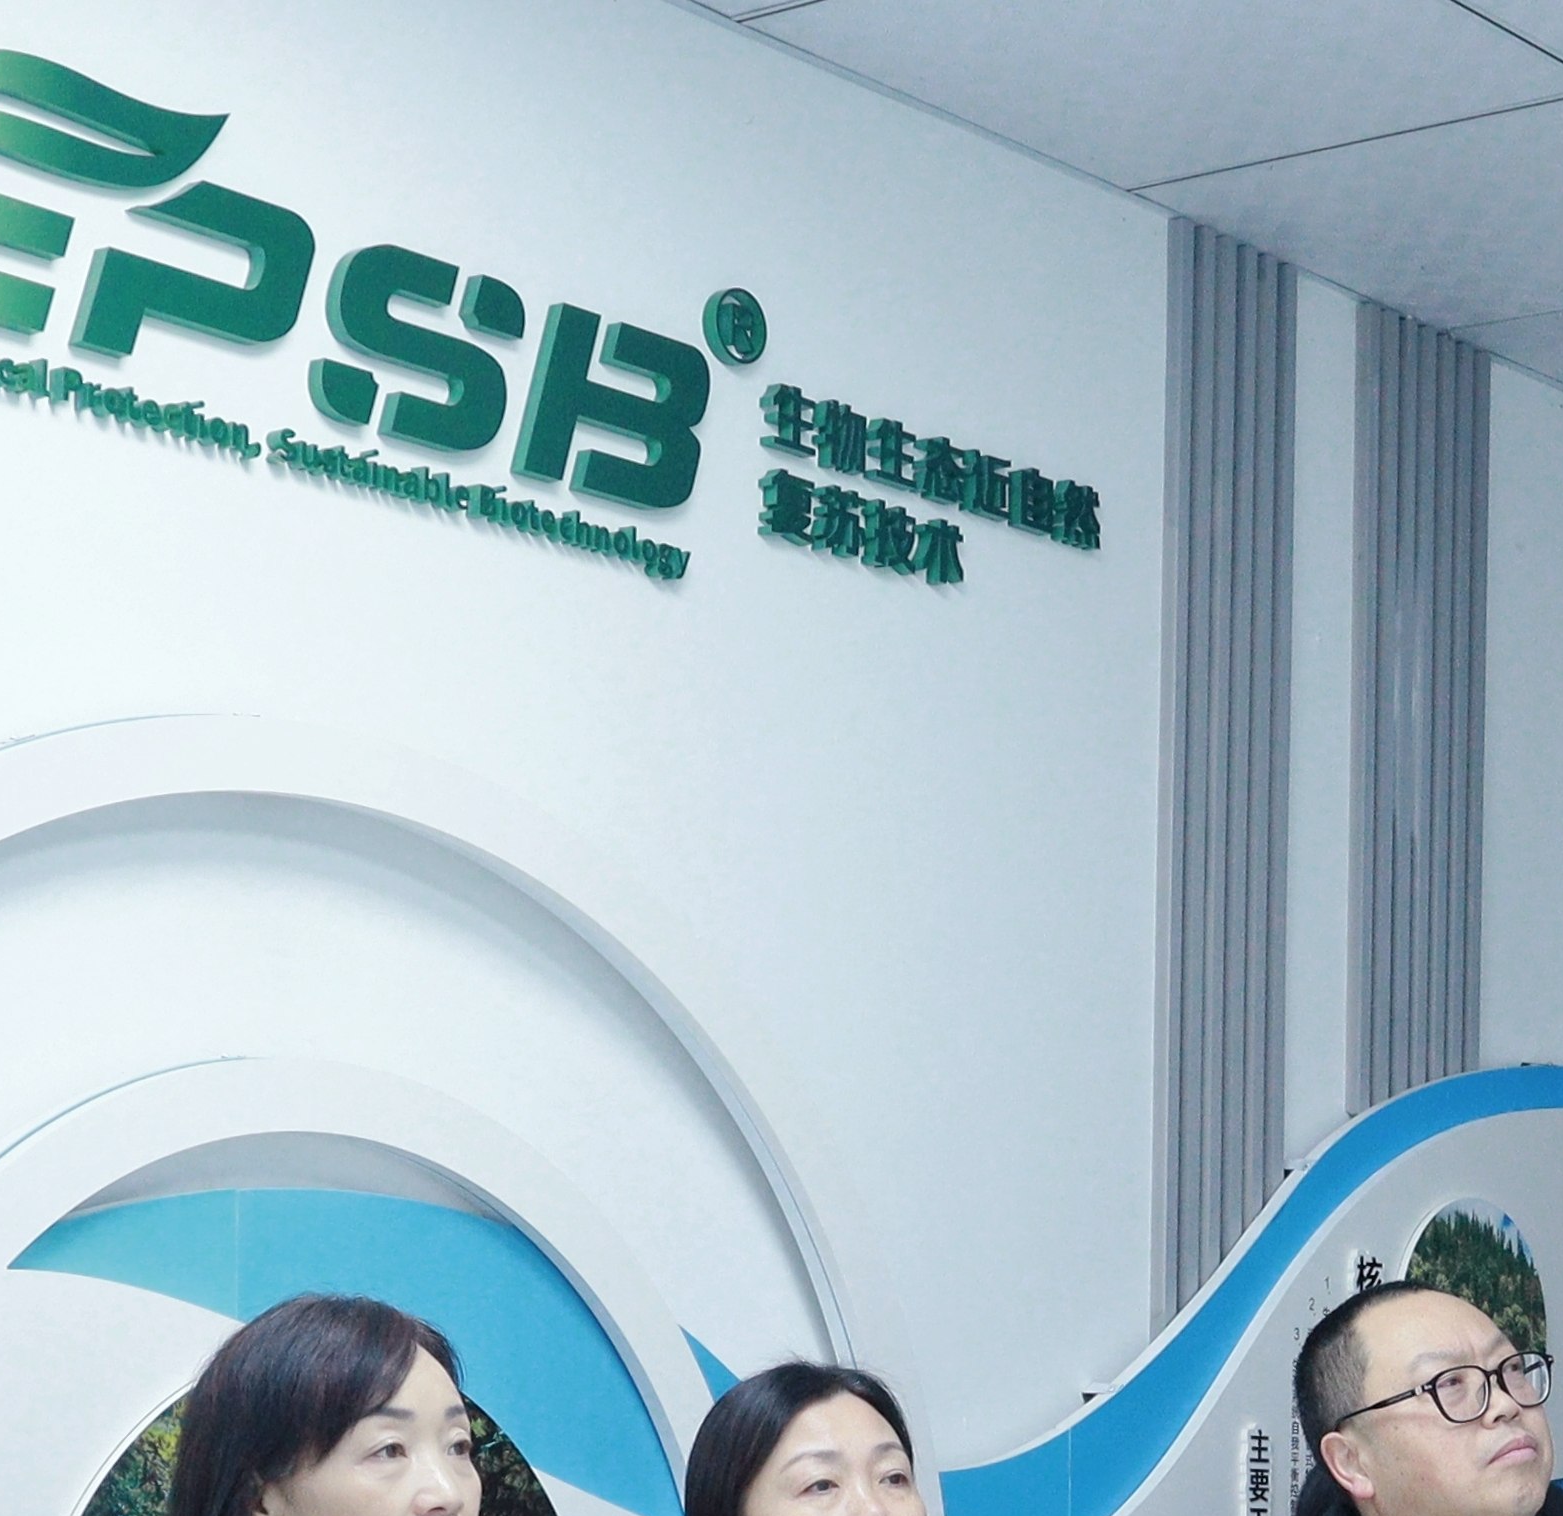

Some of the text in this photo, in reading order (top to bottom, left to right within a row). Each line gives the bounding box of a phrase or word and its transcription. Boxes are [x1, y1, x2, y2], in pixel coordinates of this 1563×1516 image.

[265, 427, 470, 511] Sustainable
[466, 484, 692, 580] Biotechnology
[757, 468, 964, 585] 复苏技术
